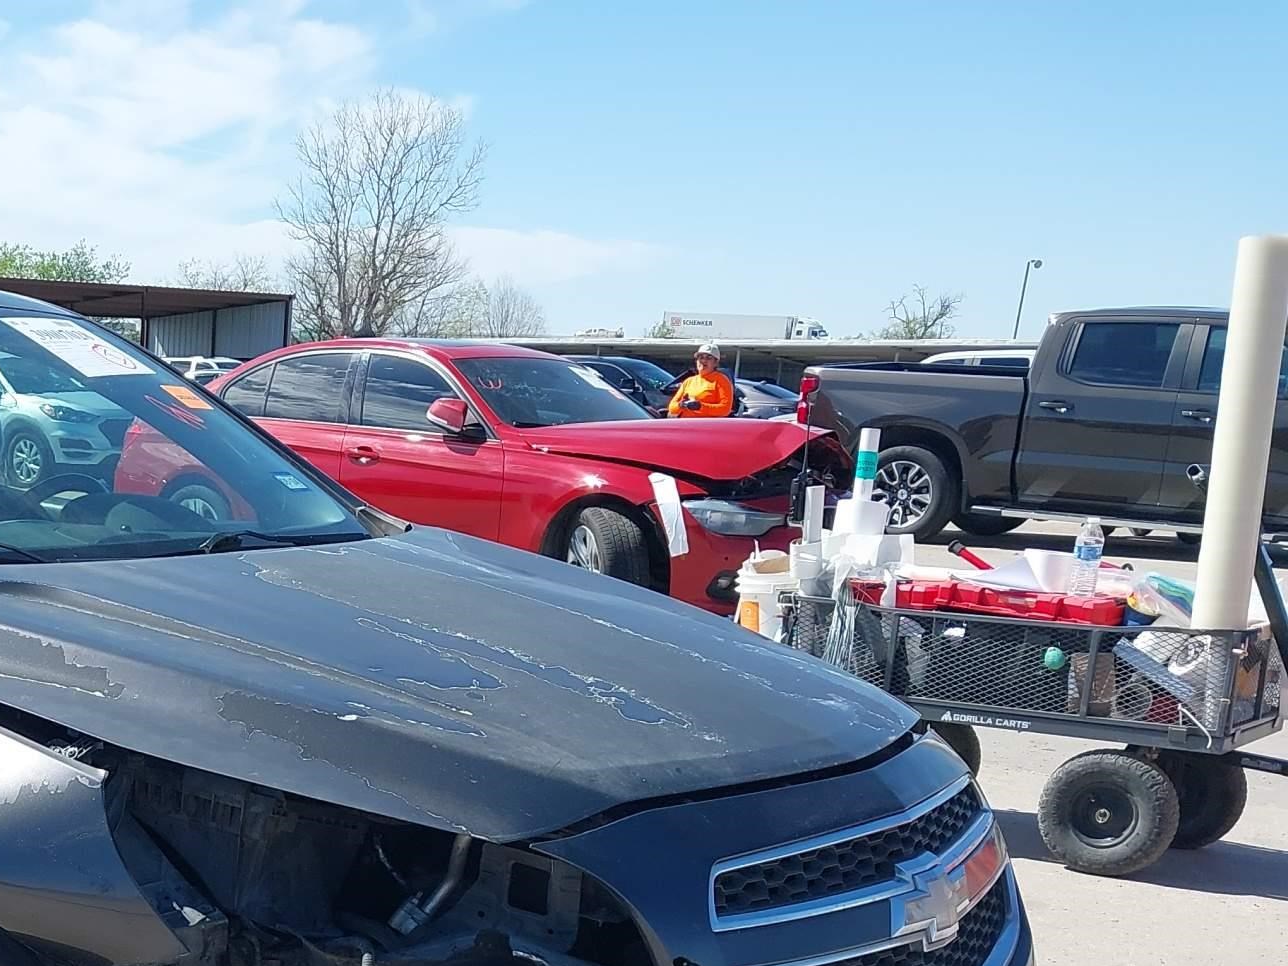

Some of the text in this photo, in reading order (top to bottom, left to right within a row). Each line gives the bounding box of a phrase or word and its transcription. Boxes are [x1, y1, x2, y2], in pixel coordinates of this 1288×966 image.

[682, 319, 713, 327] SCHENKER
[952, 713, 1030, 729] GORILLA CARTS
